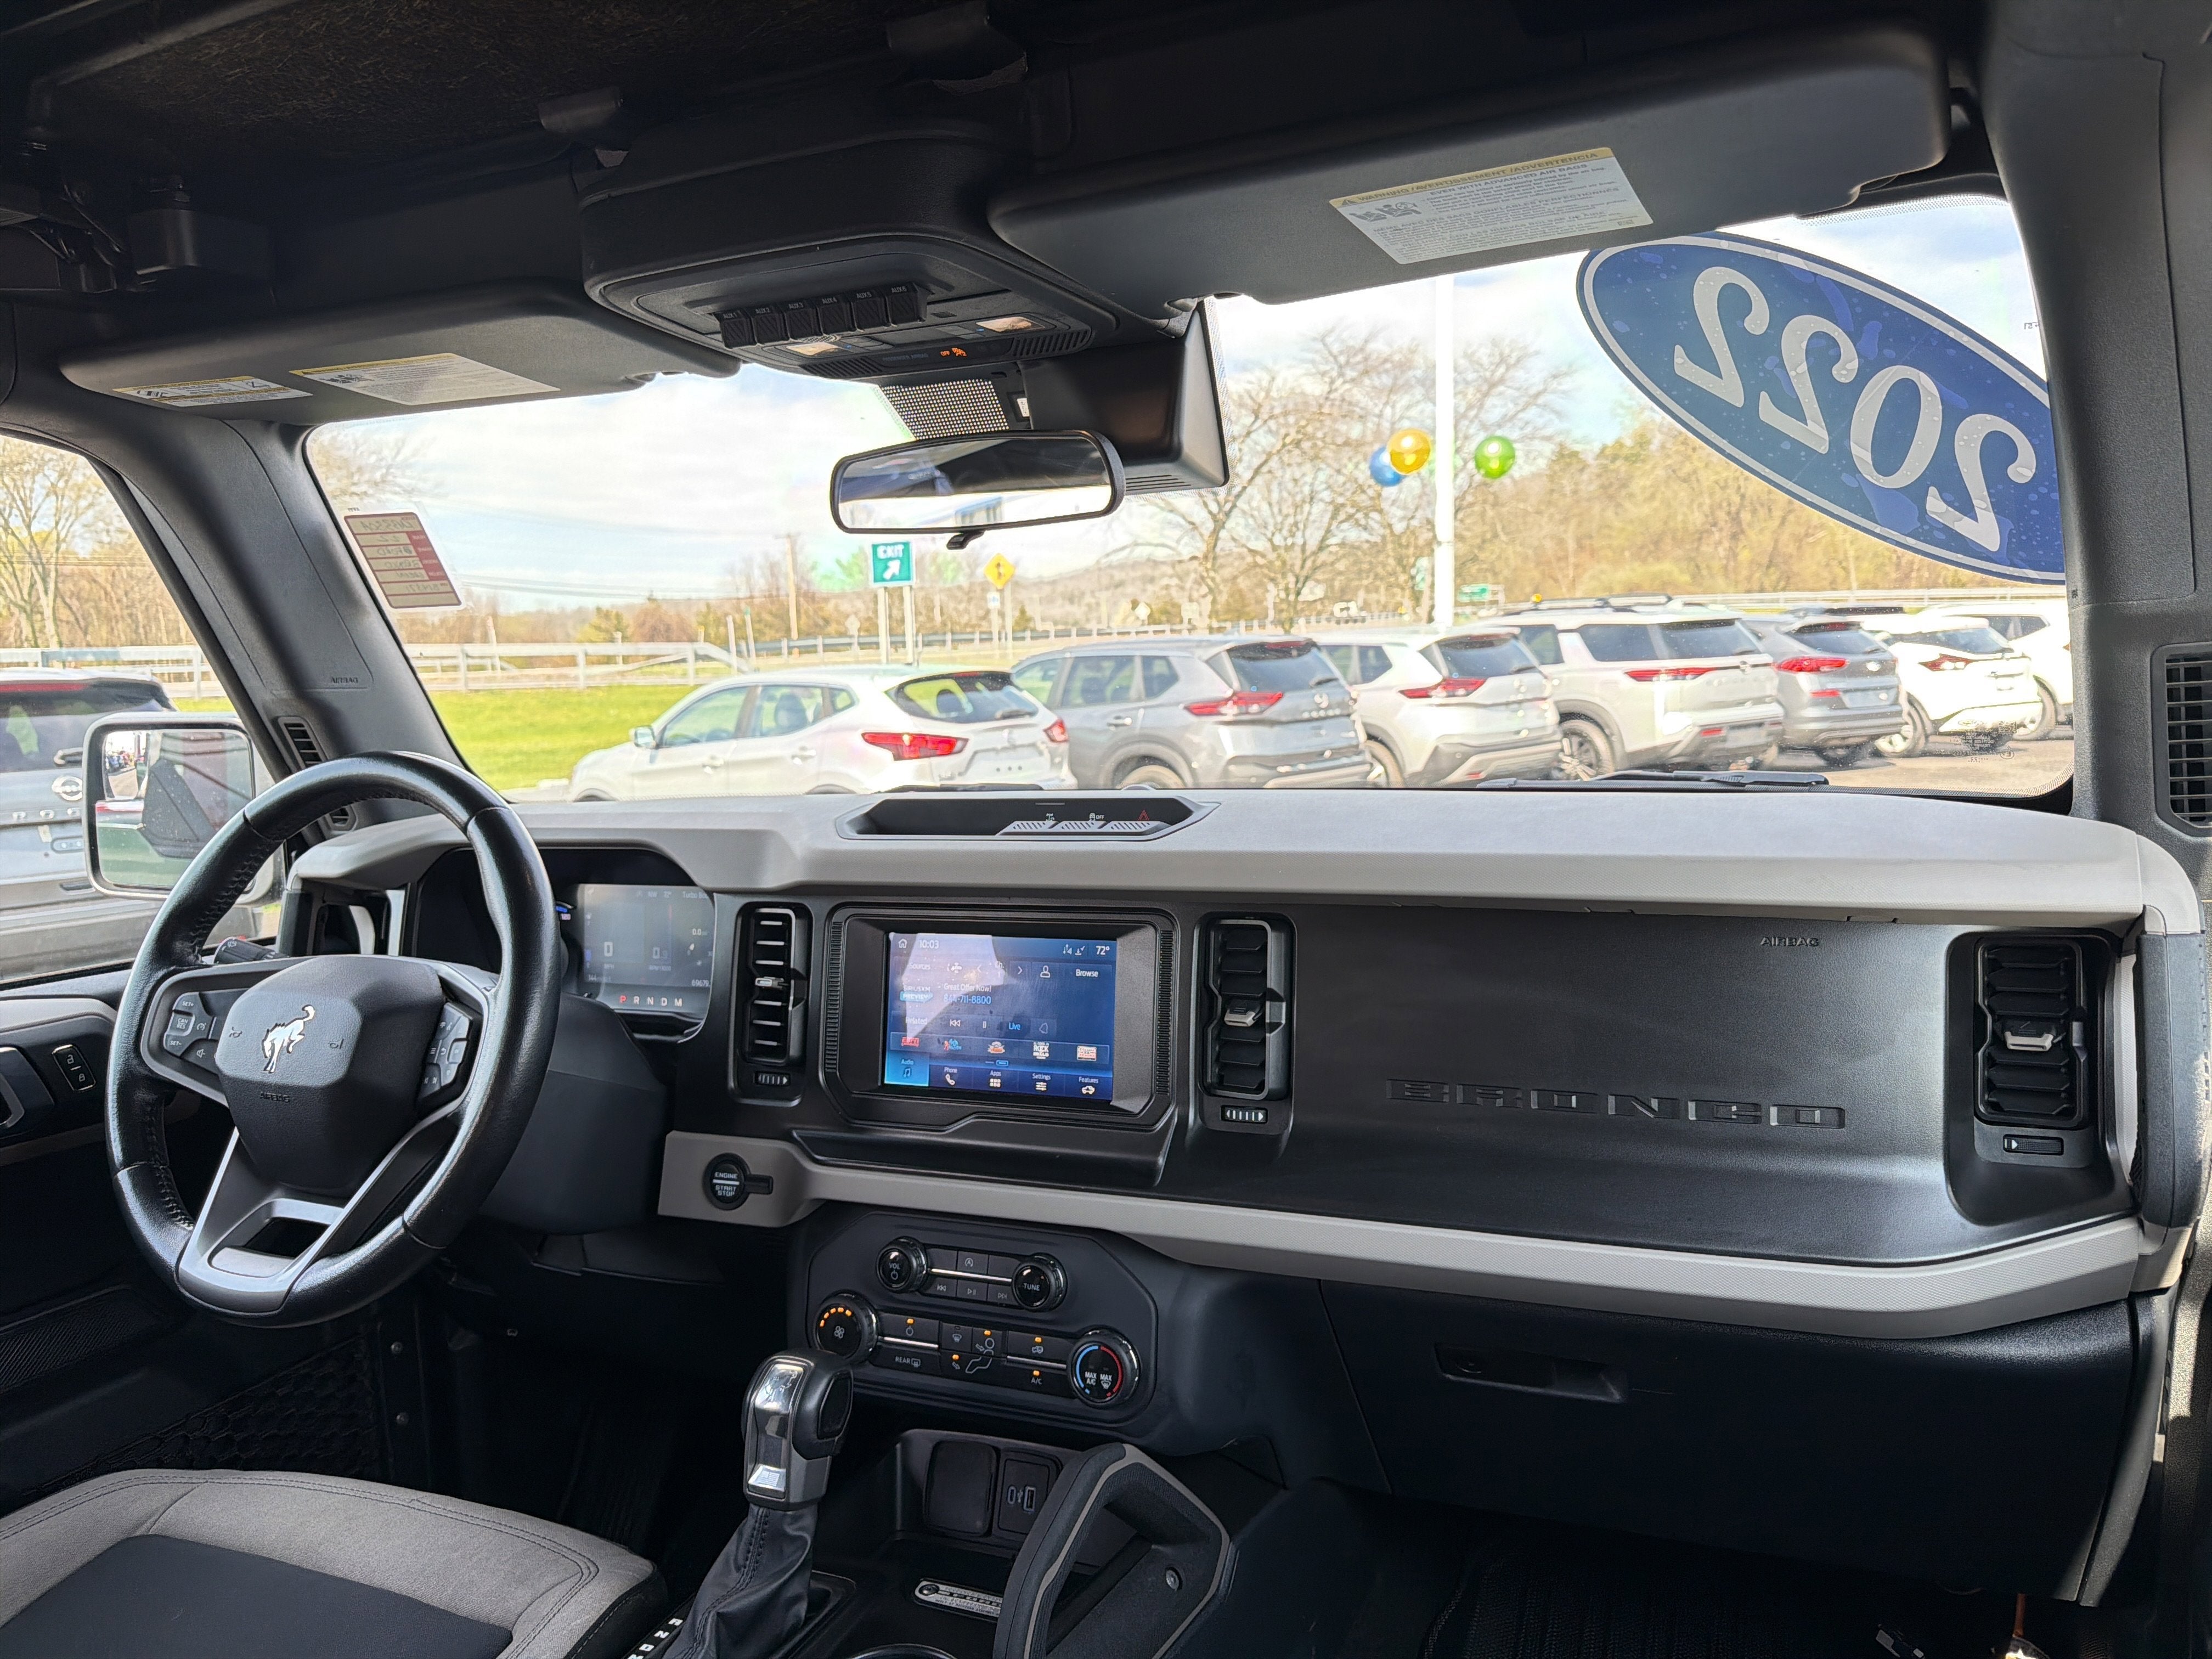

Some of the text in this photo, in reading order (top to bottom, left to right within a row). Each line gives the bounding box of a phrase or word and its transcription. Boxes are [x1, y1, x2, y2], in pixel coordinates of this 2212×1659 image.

[1483, 173, 1537, 185] ADVANCED
[1558, 163, 1587, 172] BAGS
[1357, 188, 1409, 200] WARNING
[877, 544, 904, 558] EXIT
[919, 939, 939, 949] 10:03
[1760, 937, 1819, 947] AIRBAG
[1096, 945, 1110, 956] 72°
[1076, 969, 1098, 978] Browse
[961, 983, 975, 991] Offer
[619, 995, 682, 1007] P R N D M
[259, 1092, 290, 1103] AIRBAG
[1386, 1079, 1846, 1129] BRONCO
[889, 1262, 901, 1270] VOL
[1024, 1283, 1040, 1291] TUNE
[895, 1356, 911, 1364] REAR
[1030, 1377, 1042, 1386] A/C
[653, 1630, 670, 1639] N
